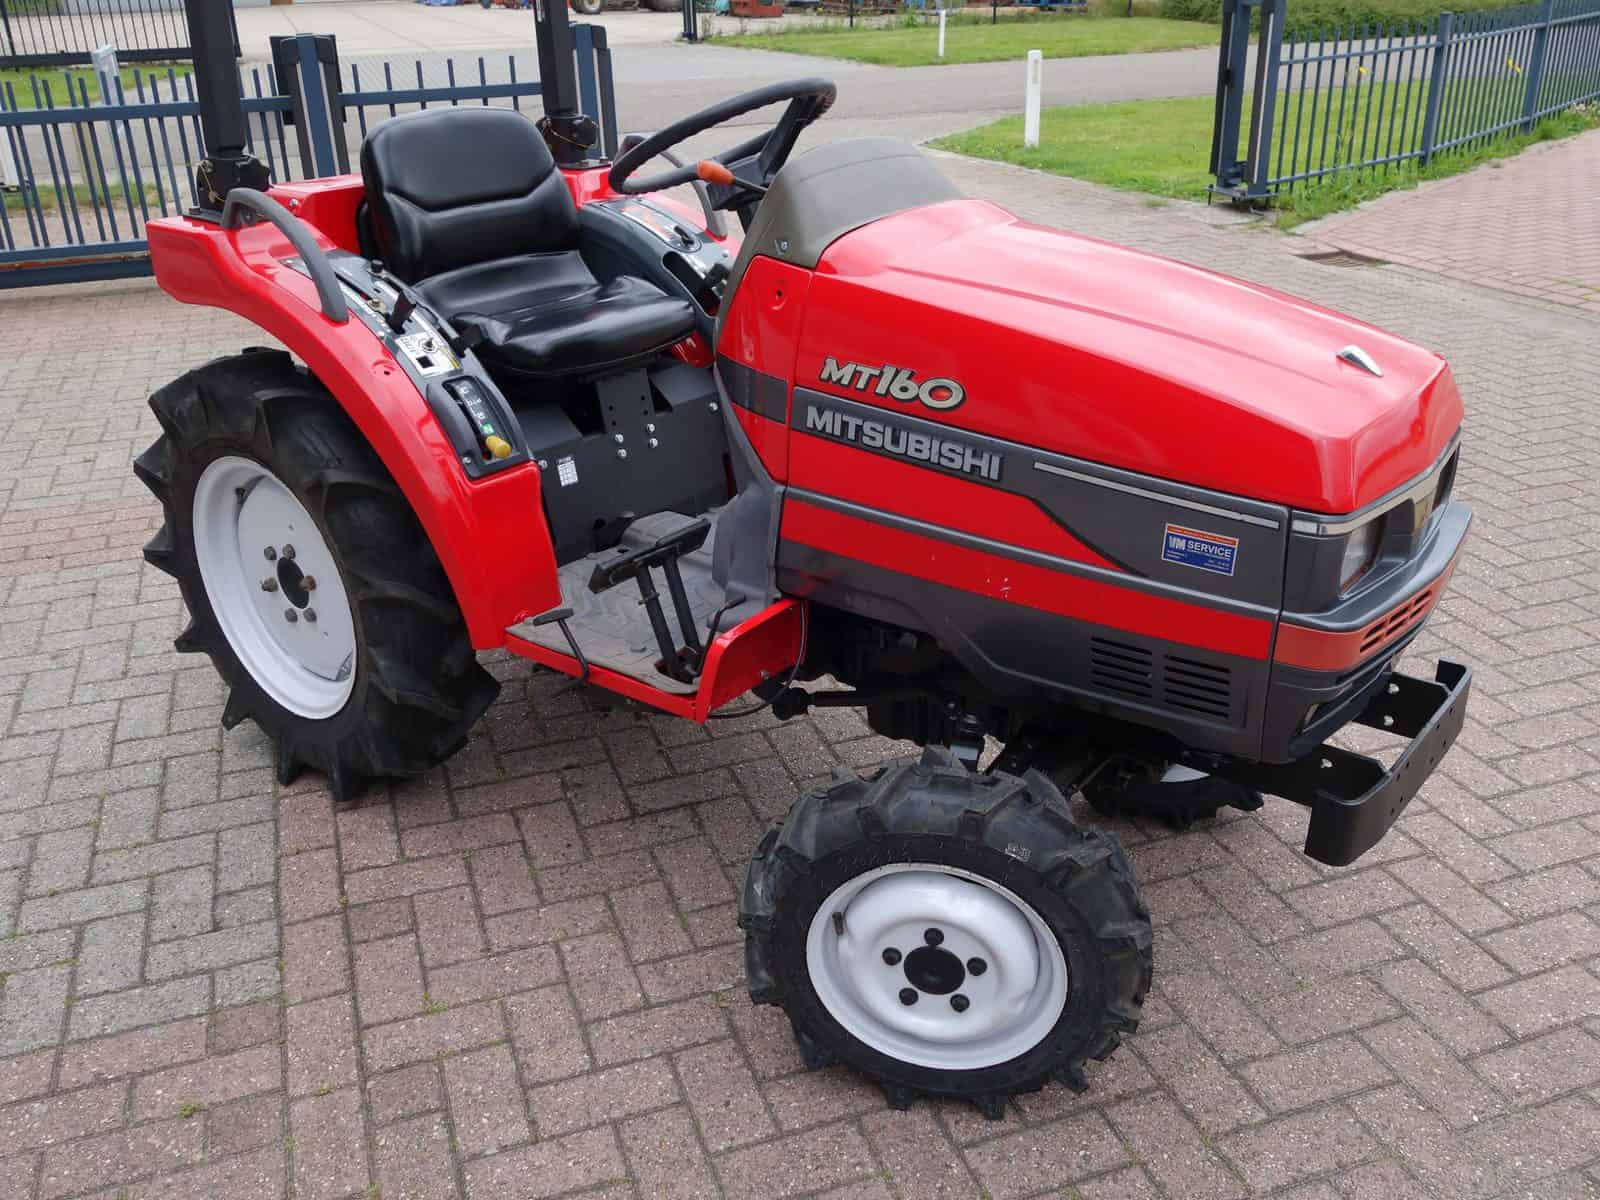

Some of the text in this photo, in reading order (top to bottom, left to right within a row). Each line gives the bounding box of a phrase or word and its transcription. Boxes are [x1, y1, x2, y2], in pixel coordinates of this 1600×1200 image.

[820, 357, 965, 409] MT160
[806, 405, 1001, 481] MITSUBISHI
[1187, 540, 1232, 558] SERVICE
